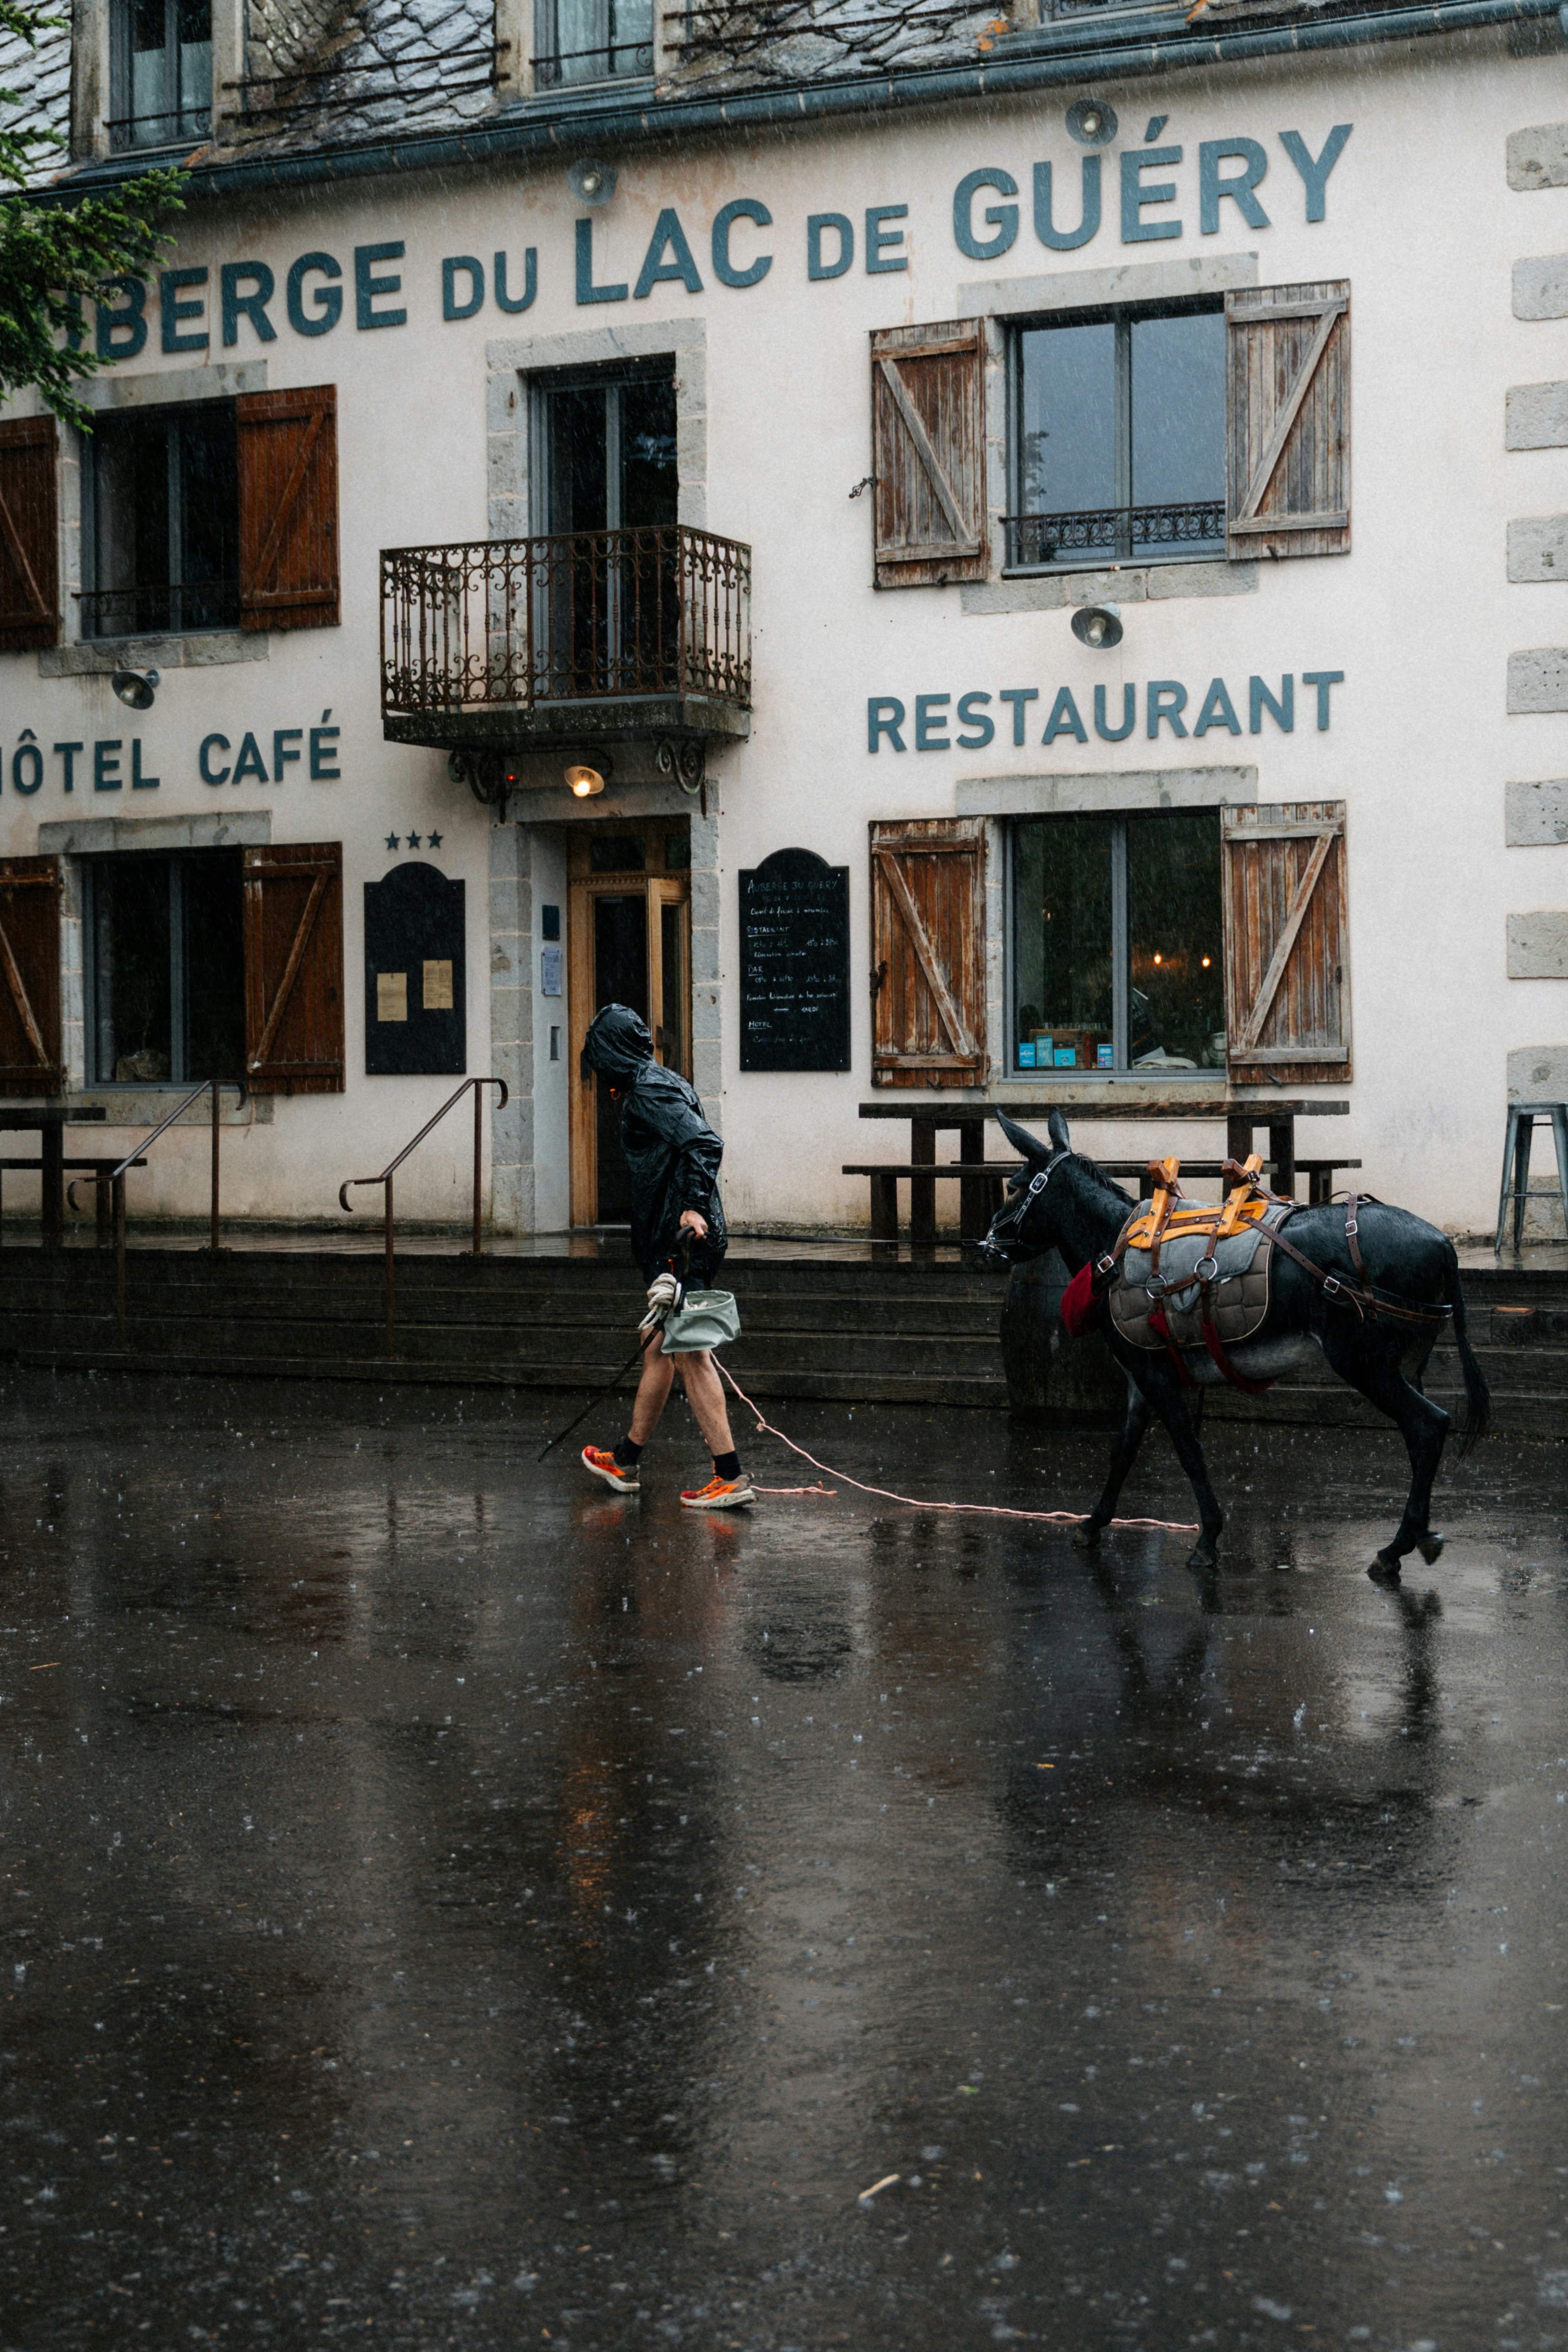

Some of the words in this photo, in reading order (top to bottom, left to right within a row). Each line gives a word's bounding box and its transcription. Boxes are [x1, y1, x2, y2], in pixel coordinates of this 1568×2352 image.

[42, 240, 407, 359] BERGE
[442, 247, 537, 321] DU
[575, 198, 773, 305] LAC
[807, 204, 909, 281] DE
[952, 114, 1354, 260] GUÉRY
[0, 728, 160, 795] ÔTEL
[199, 708, 341, 786] CAFÉ
[867, 670, 1344, 753] RESTAURANT
[748, 879, 788, 893] AUBERGE
[792, 881, 804, 890] DU
[808, 880, 838, 890] GUERY
[747, 964, 764, 974] BAR
